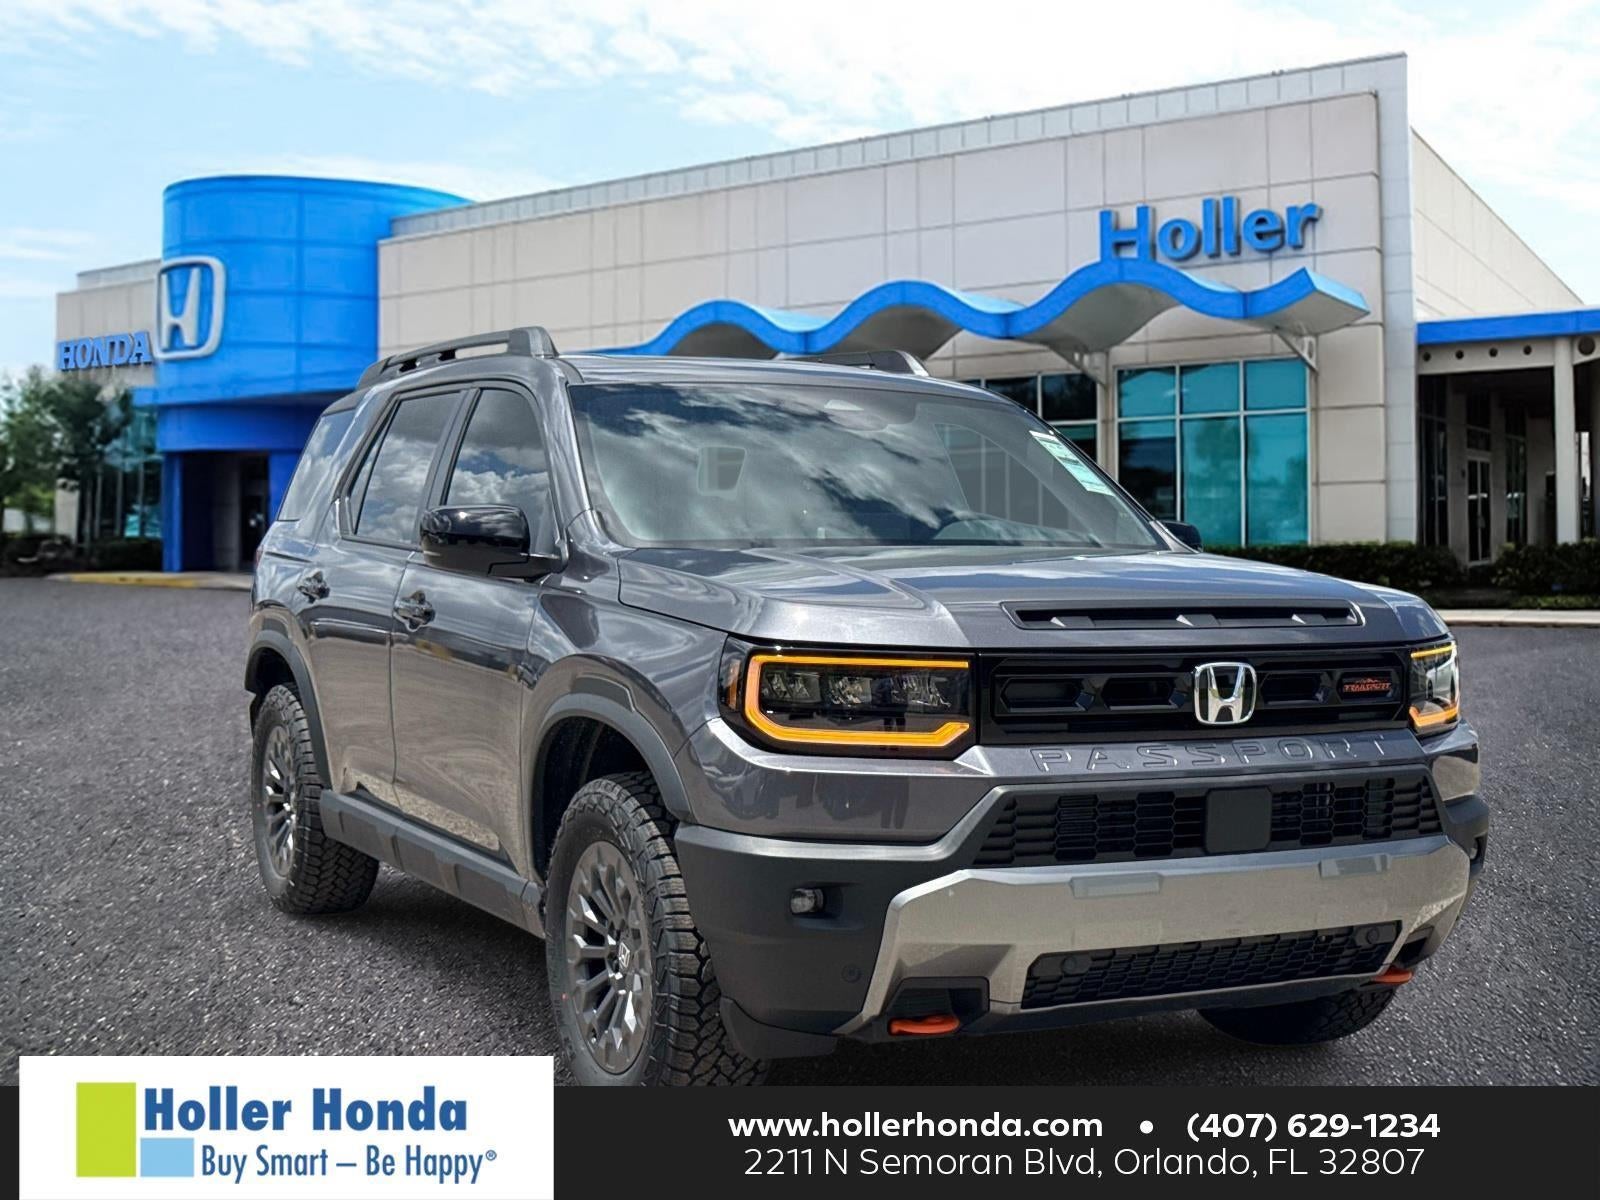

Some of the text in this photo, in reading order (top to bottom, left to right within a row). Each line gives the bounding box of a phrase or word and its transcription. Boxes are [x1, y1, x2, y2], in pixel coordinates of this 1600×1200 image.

[1099, 196, 1322, 261] Holler
[57, 331, 152, 371] HONDA
[1030, 734, 1388, 772] PASSPORT
